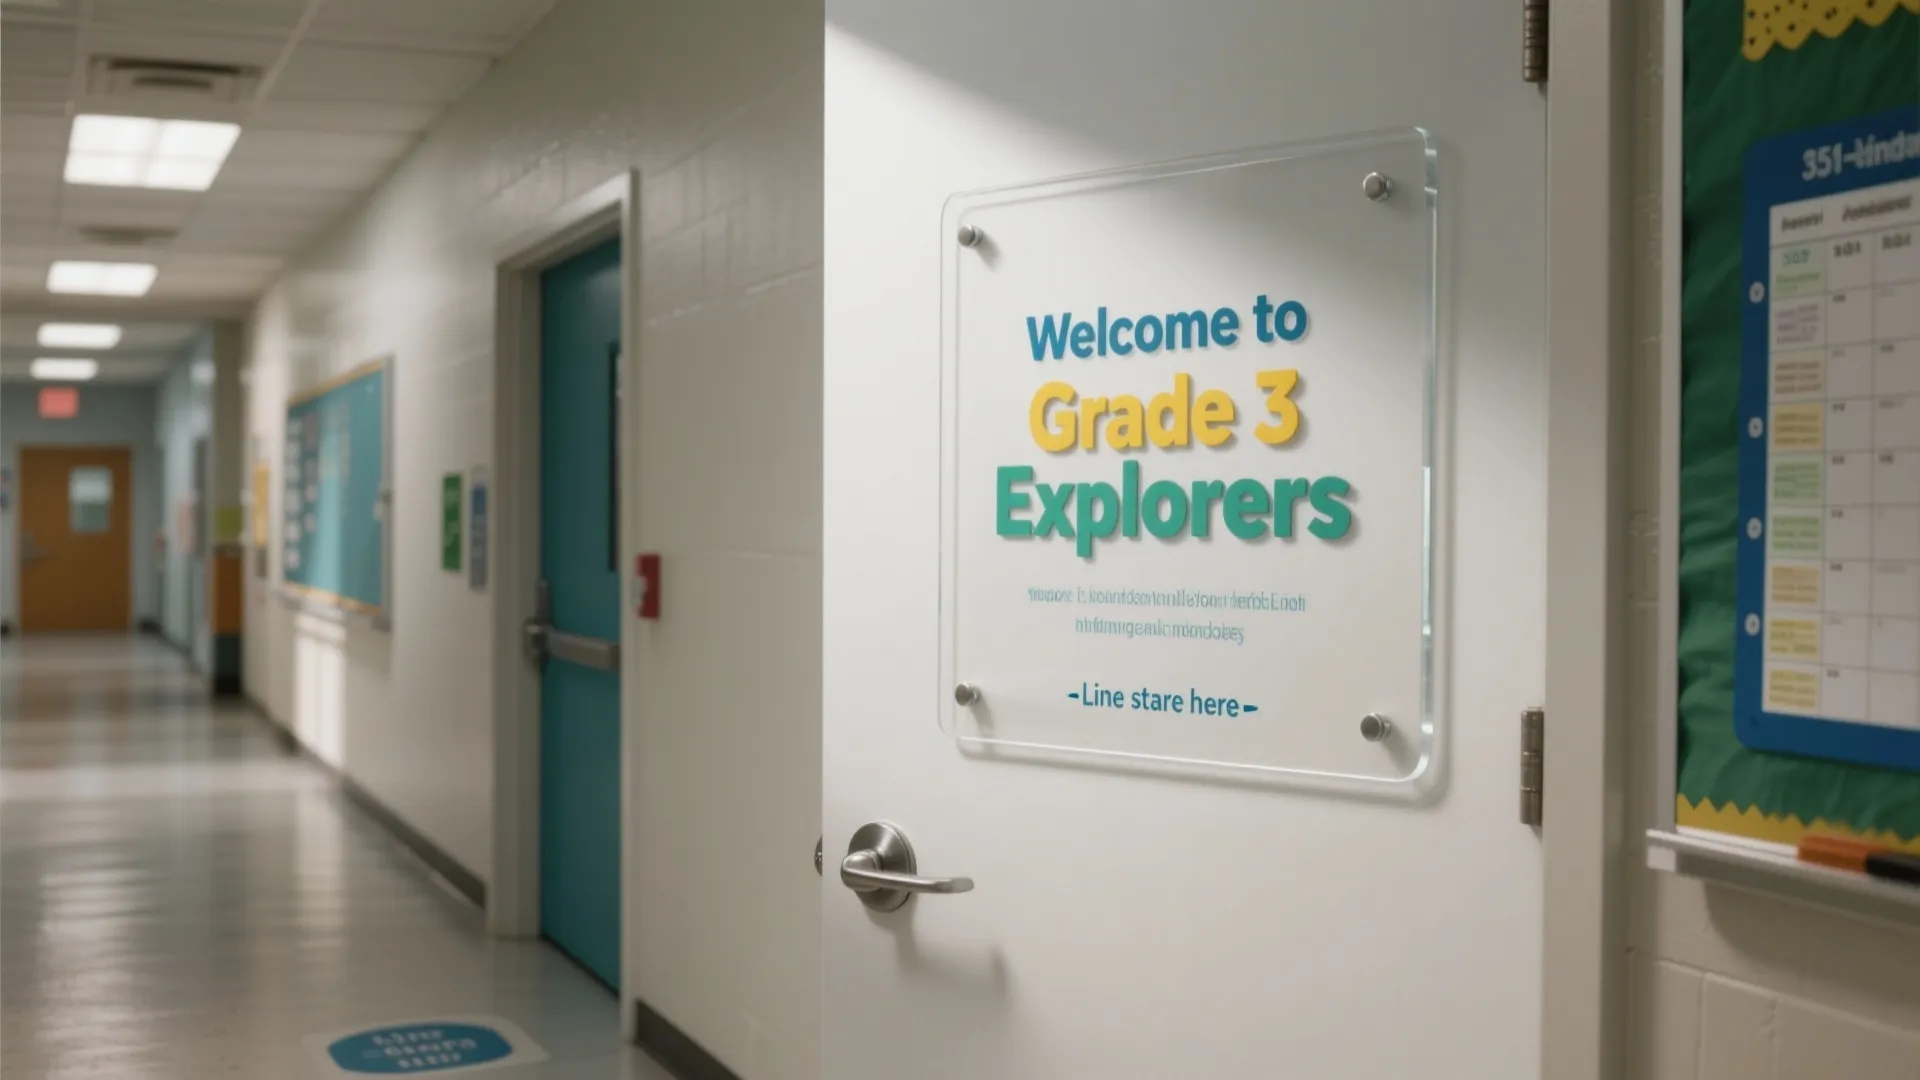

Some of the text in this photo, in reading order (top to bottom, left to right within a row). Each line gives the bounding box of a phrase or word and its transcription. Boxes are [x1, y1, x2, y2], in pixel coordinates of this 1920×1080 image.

[1026, 294, 1308, 361] Welcome to
[1029, 369, 1301, 453] Grade 3
[996, 460, 1353, 558] Explorers
[1131, 687, 1184, 713] stare
